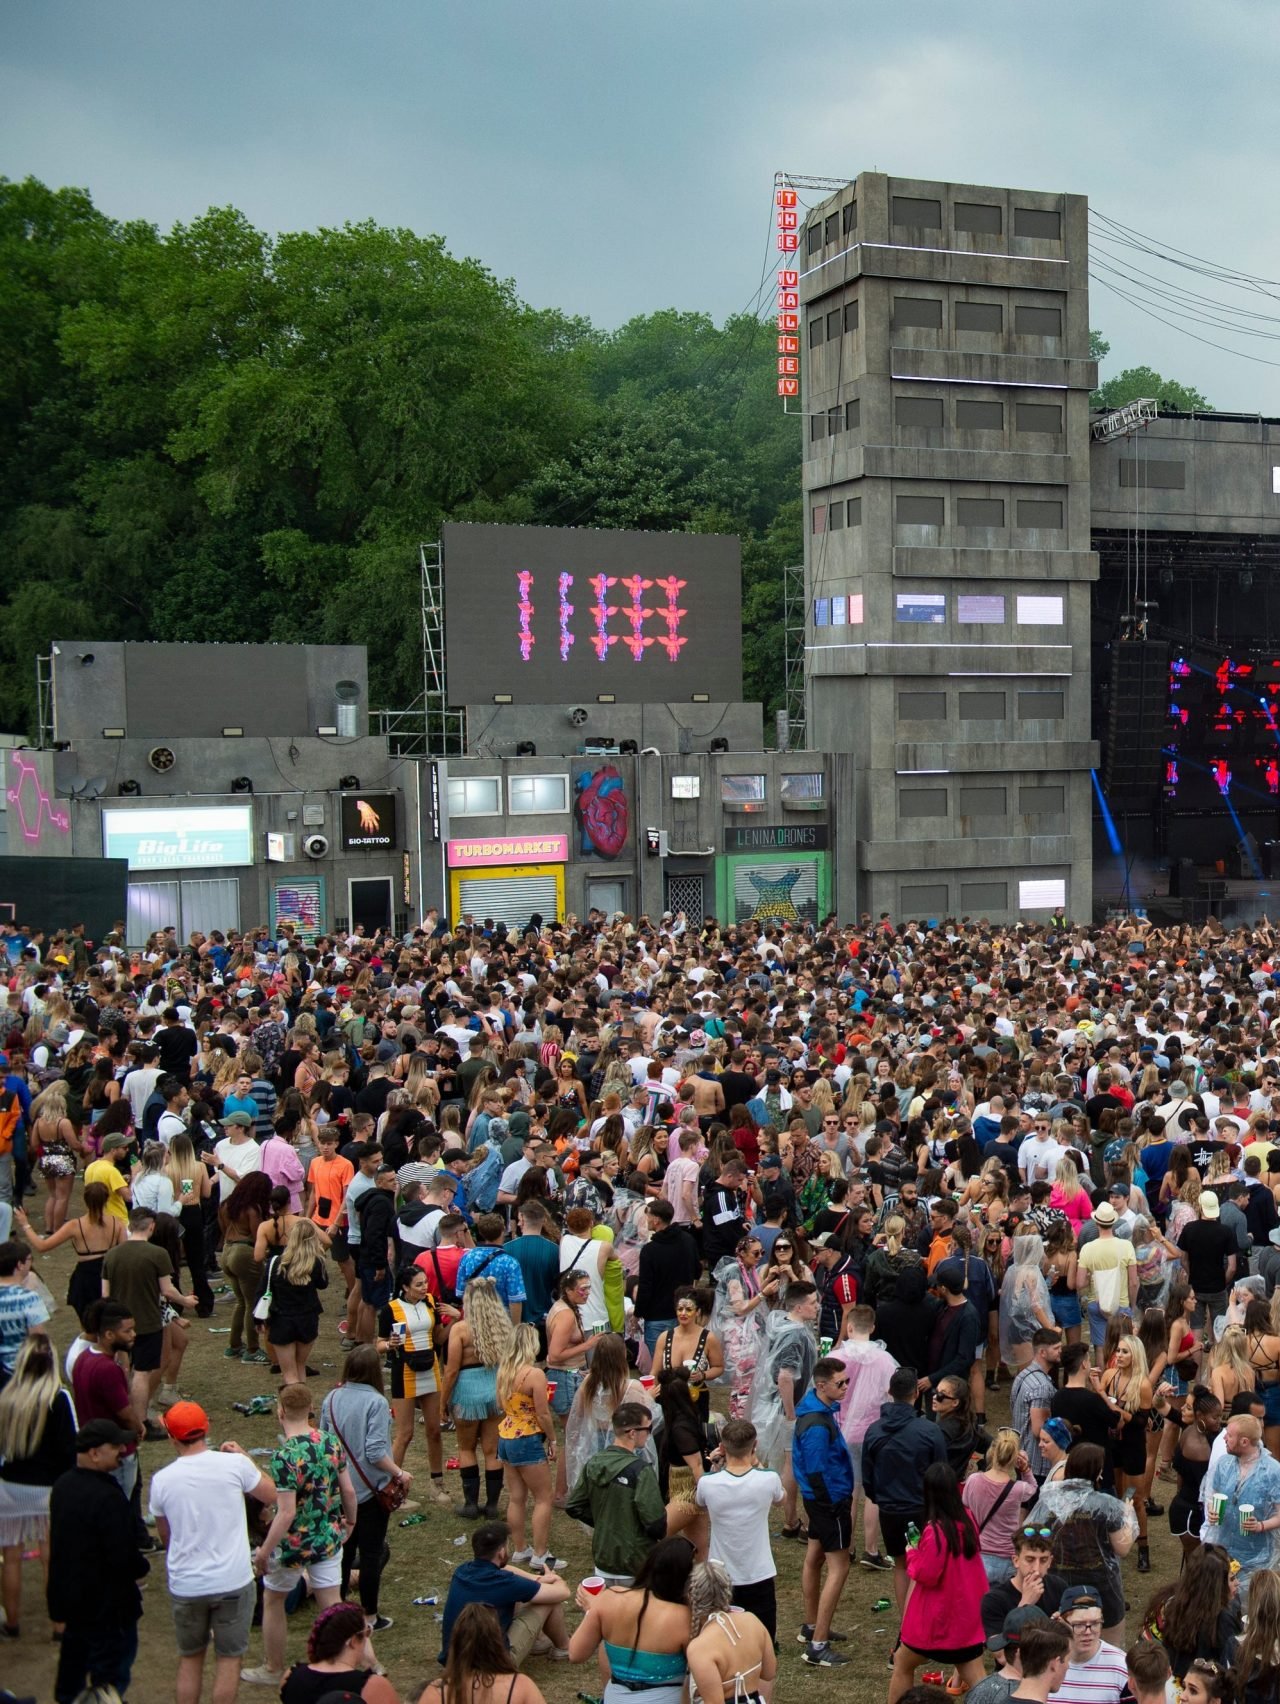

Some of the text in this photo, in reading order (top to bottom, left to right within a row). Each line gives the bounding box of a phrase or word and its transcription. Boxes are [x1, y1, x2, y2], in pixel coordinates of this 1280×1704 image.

[784, 272, 797, 394] VALLEY
[136, 838, 224, 857] BigLife
[454, 841, 561, 858] TURBOMARKET
